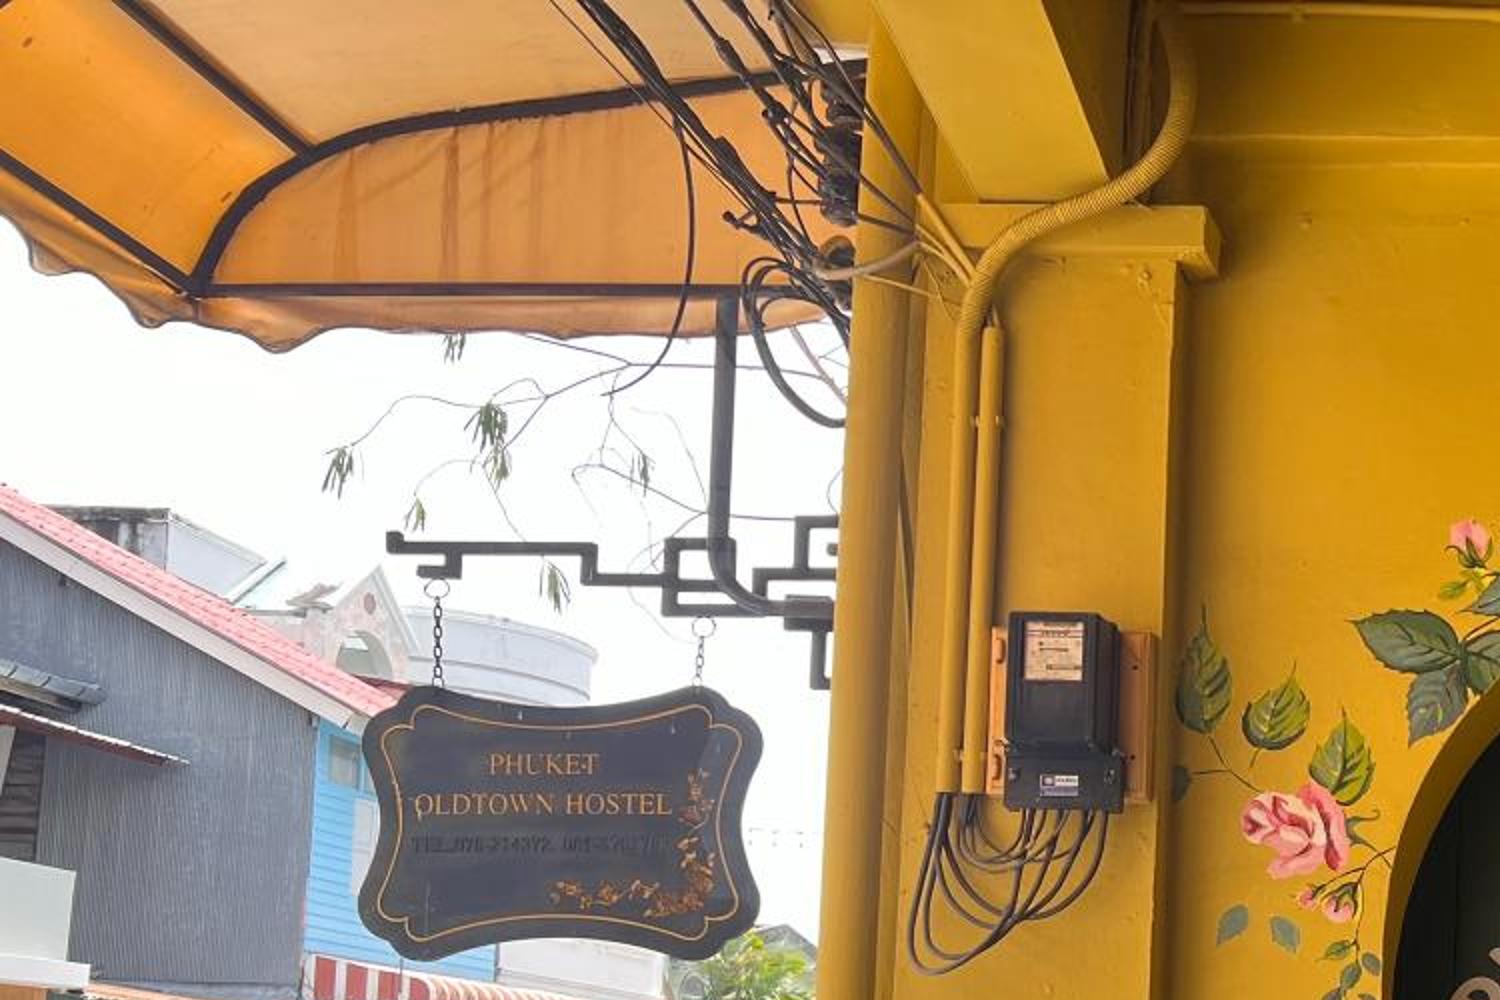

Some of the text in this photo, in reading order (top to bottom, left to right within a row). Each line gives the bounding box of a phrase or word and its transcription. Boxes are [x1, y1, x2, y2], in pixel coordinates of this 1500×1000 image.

[488, 752, 599, 776] PHUKET
[413, 792, 673, 819] OLDTOWN HOSTEL
